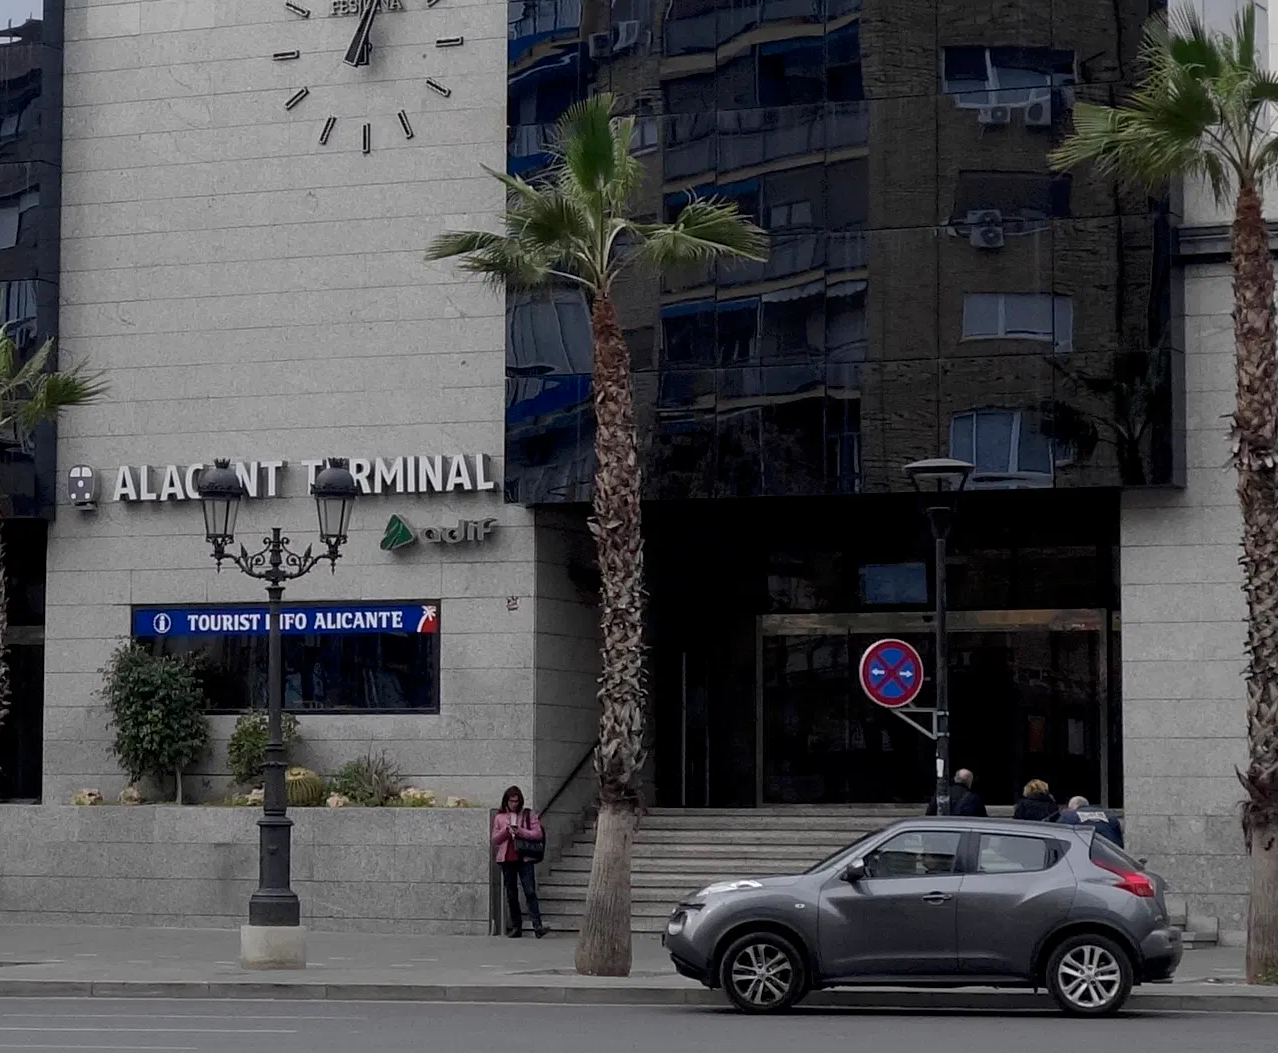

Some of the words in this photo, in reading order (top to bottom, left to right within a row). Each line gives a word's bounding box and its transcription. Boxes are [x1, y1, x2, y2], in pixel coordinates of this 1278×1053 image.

[113, 460, 284, 501] ALACNT
[301, 453, 494, 495] TRMINAL
[423, 517, 498, 543] adif
[187, 613, 261, 631] TOURIST
[313, 611, 403, 629] ALICANTE
